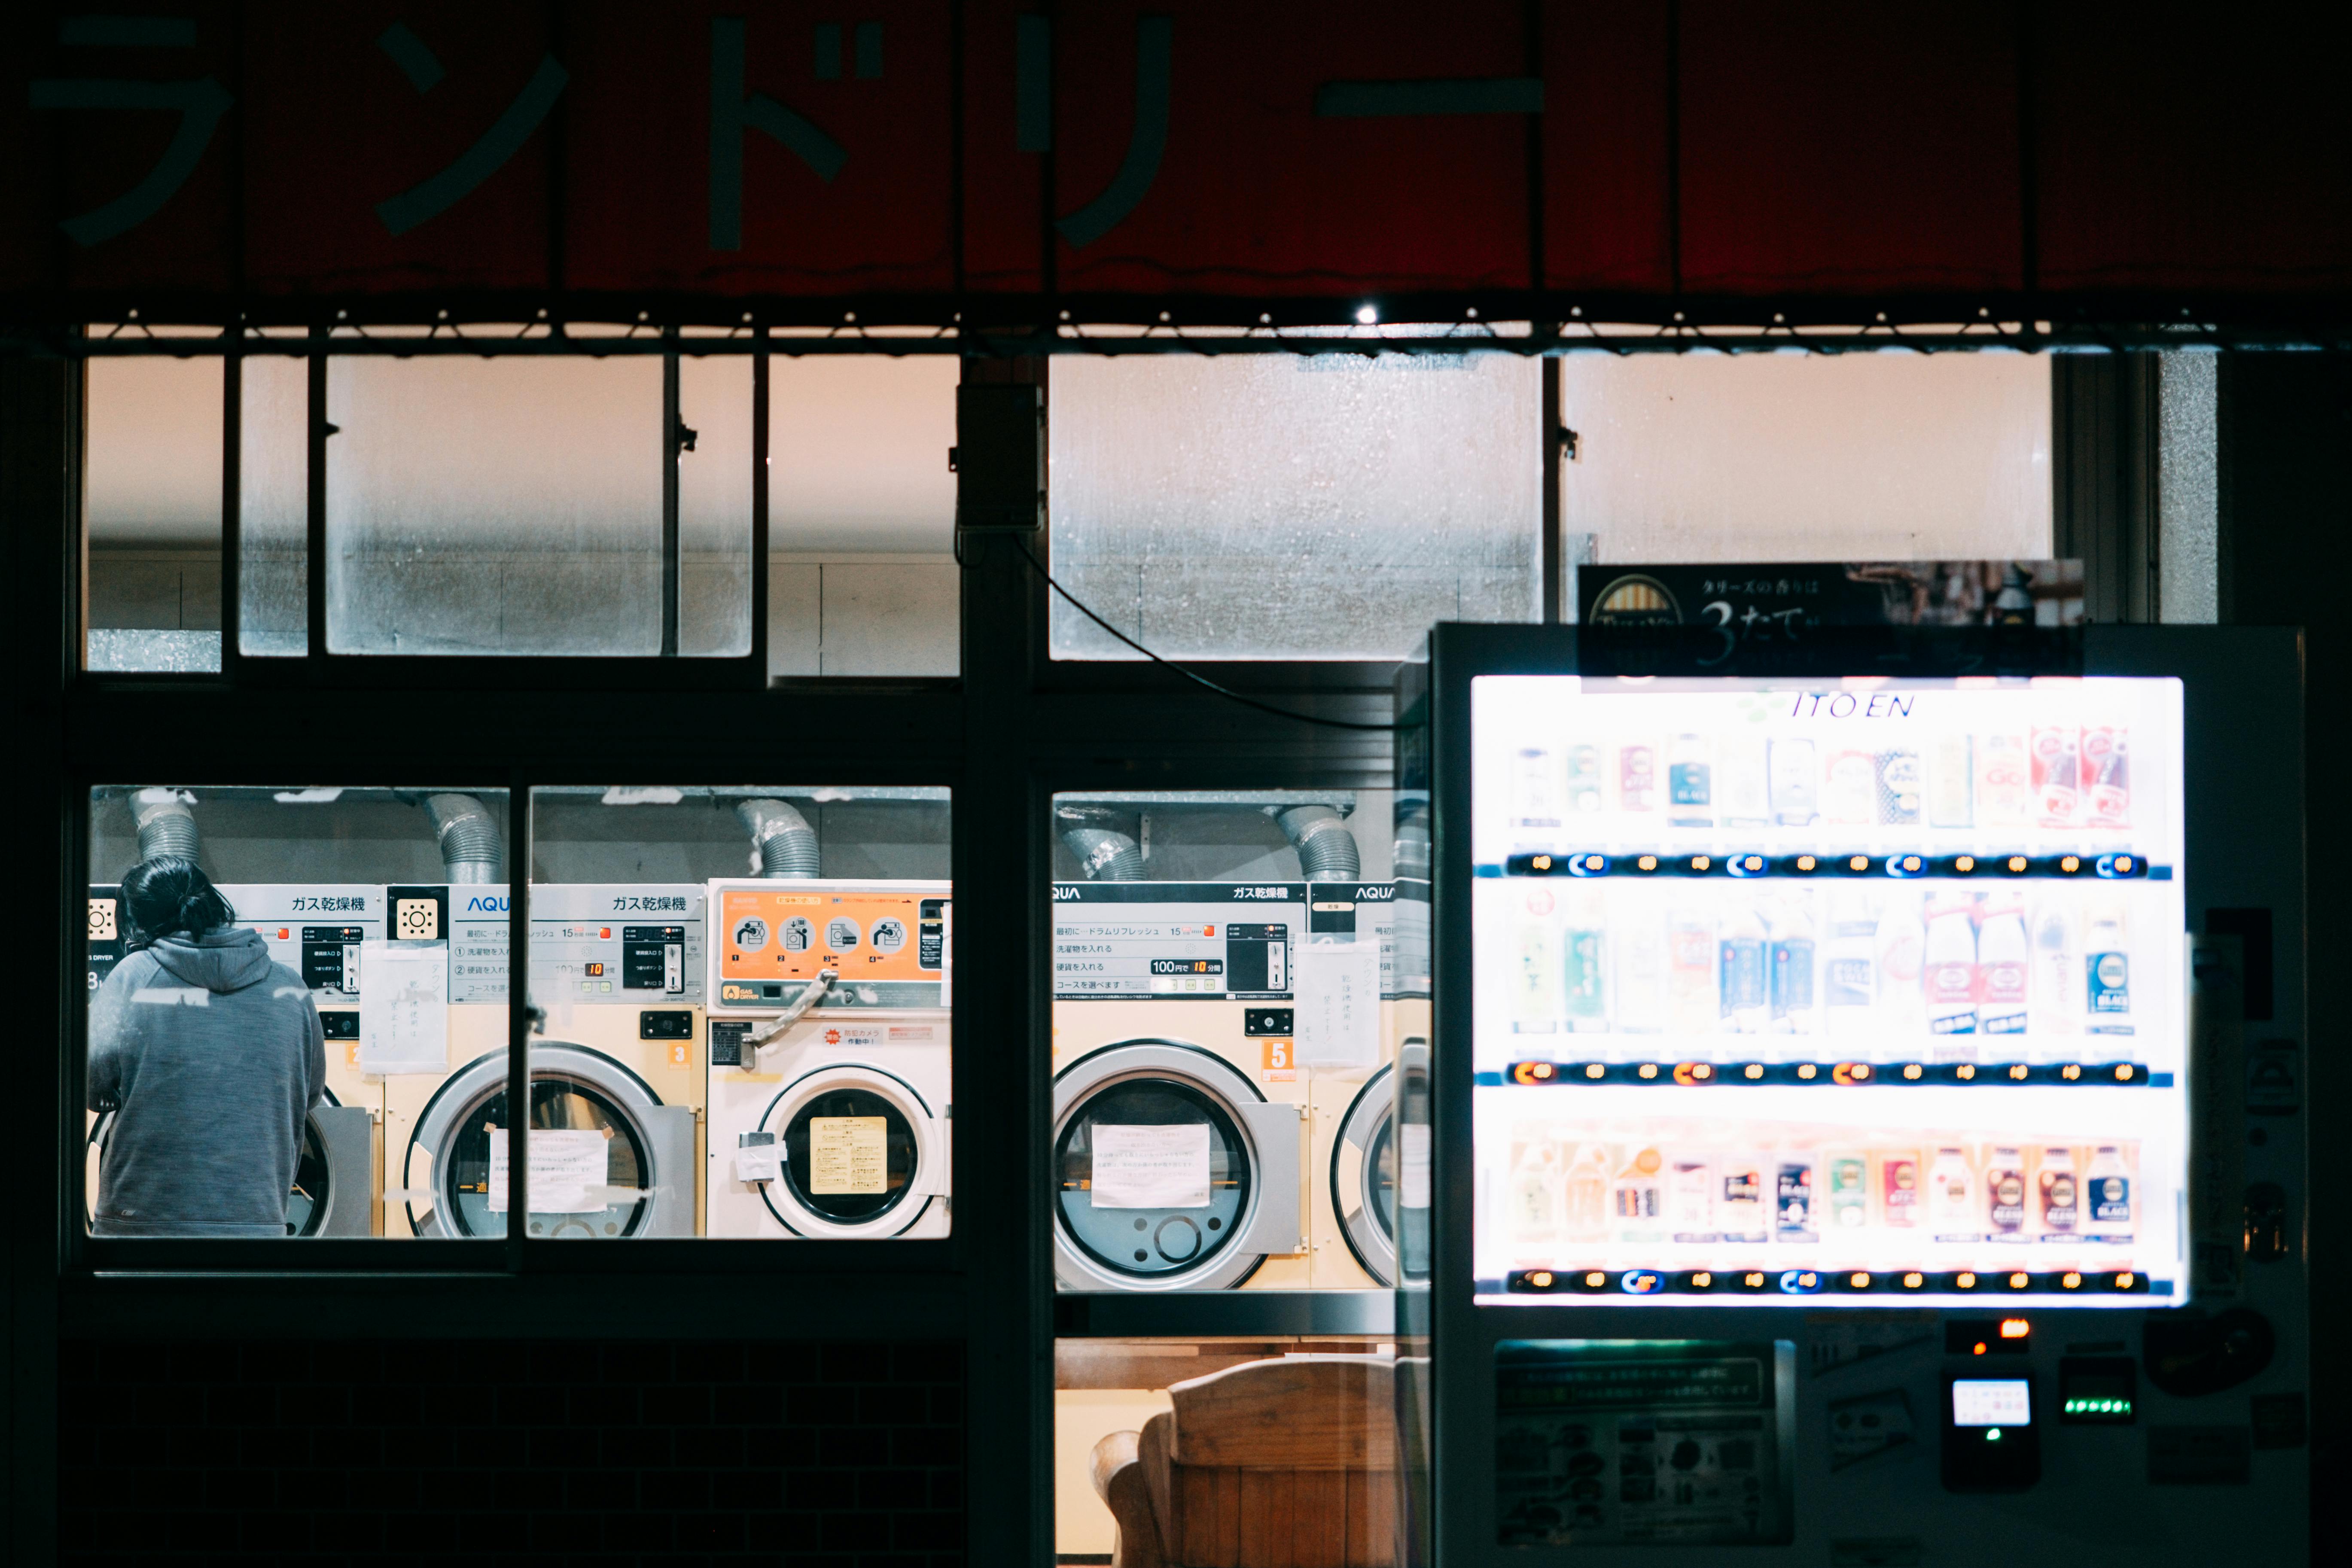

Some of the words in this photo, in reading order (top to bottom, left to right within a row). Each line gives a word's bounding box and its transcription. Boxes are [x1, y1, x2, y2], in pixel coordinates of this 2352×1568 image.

[28, 13, 1544, 250] ランドリー
[1792, 692, 1856, 718] ITO
[1866, 694, 1915, 718] EN
[1234, 887, 1288, 898] ガス乾燥機
[292, 897, 365, 911] ガス乾燥機
[613, 896, 686, 911] ガス乾燥機
[562, 929, 573, 937] 15
[1170, 928, 1181, 936] 15
[1056, 945, 1112, 953] 洗濯物を入れる
[591, 964, 602, 974] 10
[1056, 963, 1103, 971] 硬貨を入れる
[1194, 961, 1206, 972] 10
[675, 1046, 685, 1062] 3
[1271, 1043, 1286, 1068] 5
